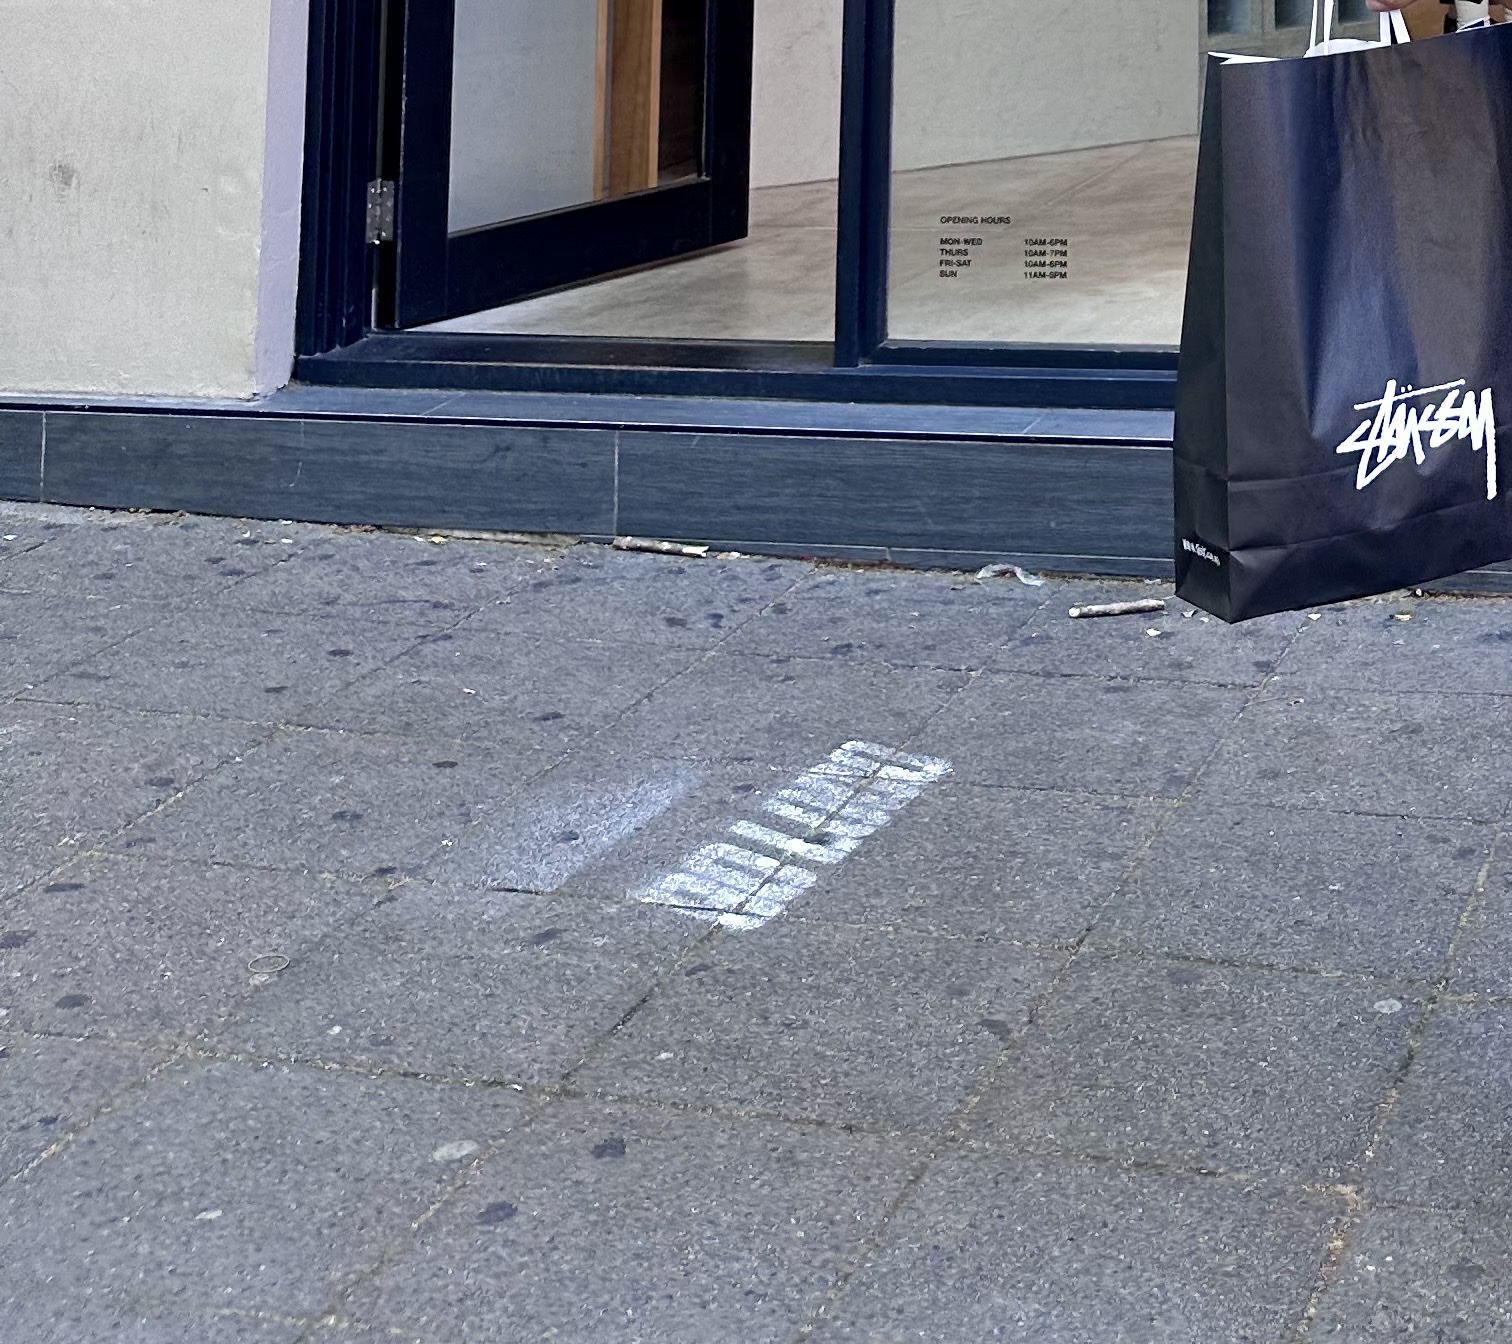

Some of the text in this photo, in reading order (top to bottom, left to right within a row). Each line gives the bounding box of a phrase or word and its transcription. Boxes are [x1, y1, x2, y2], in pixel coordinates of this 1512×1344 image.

[939, 215, 1011, 224] OPENING HOURS
[939, 248, 1067, 257] THURS 10AM-7PM
[939, 259, 971, 267] FRI-SAT
[938, 269, 957, 278] SUN
